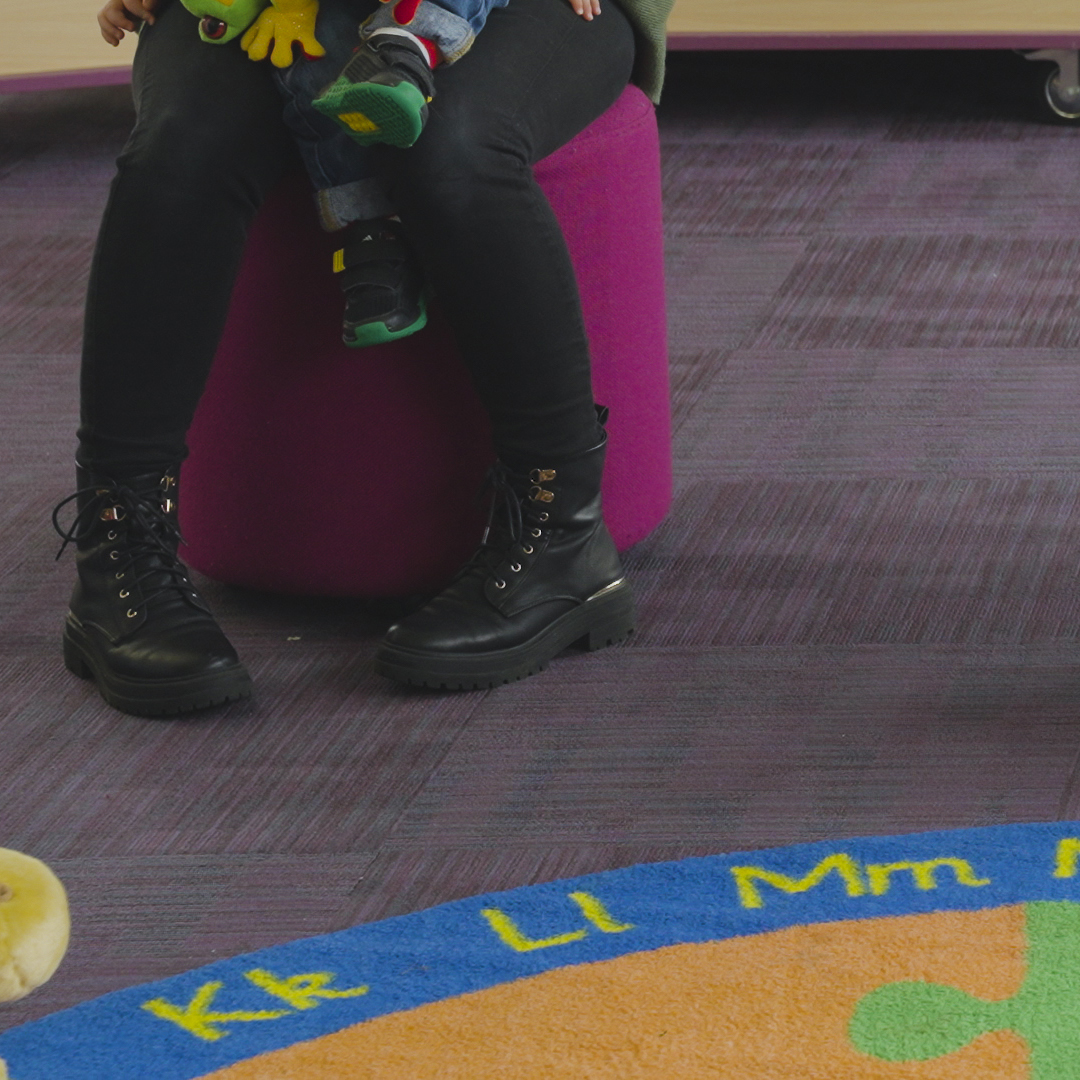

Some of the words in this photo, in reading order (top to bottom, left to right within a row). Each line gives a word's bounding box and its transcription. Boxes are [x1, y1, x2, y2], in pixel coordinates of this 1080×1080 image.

[144, 969, 367, 1041] Kk
[483, 892, 632, 952] Ll
[732, 853, 989, 908] Mm
